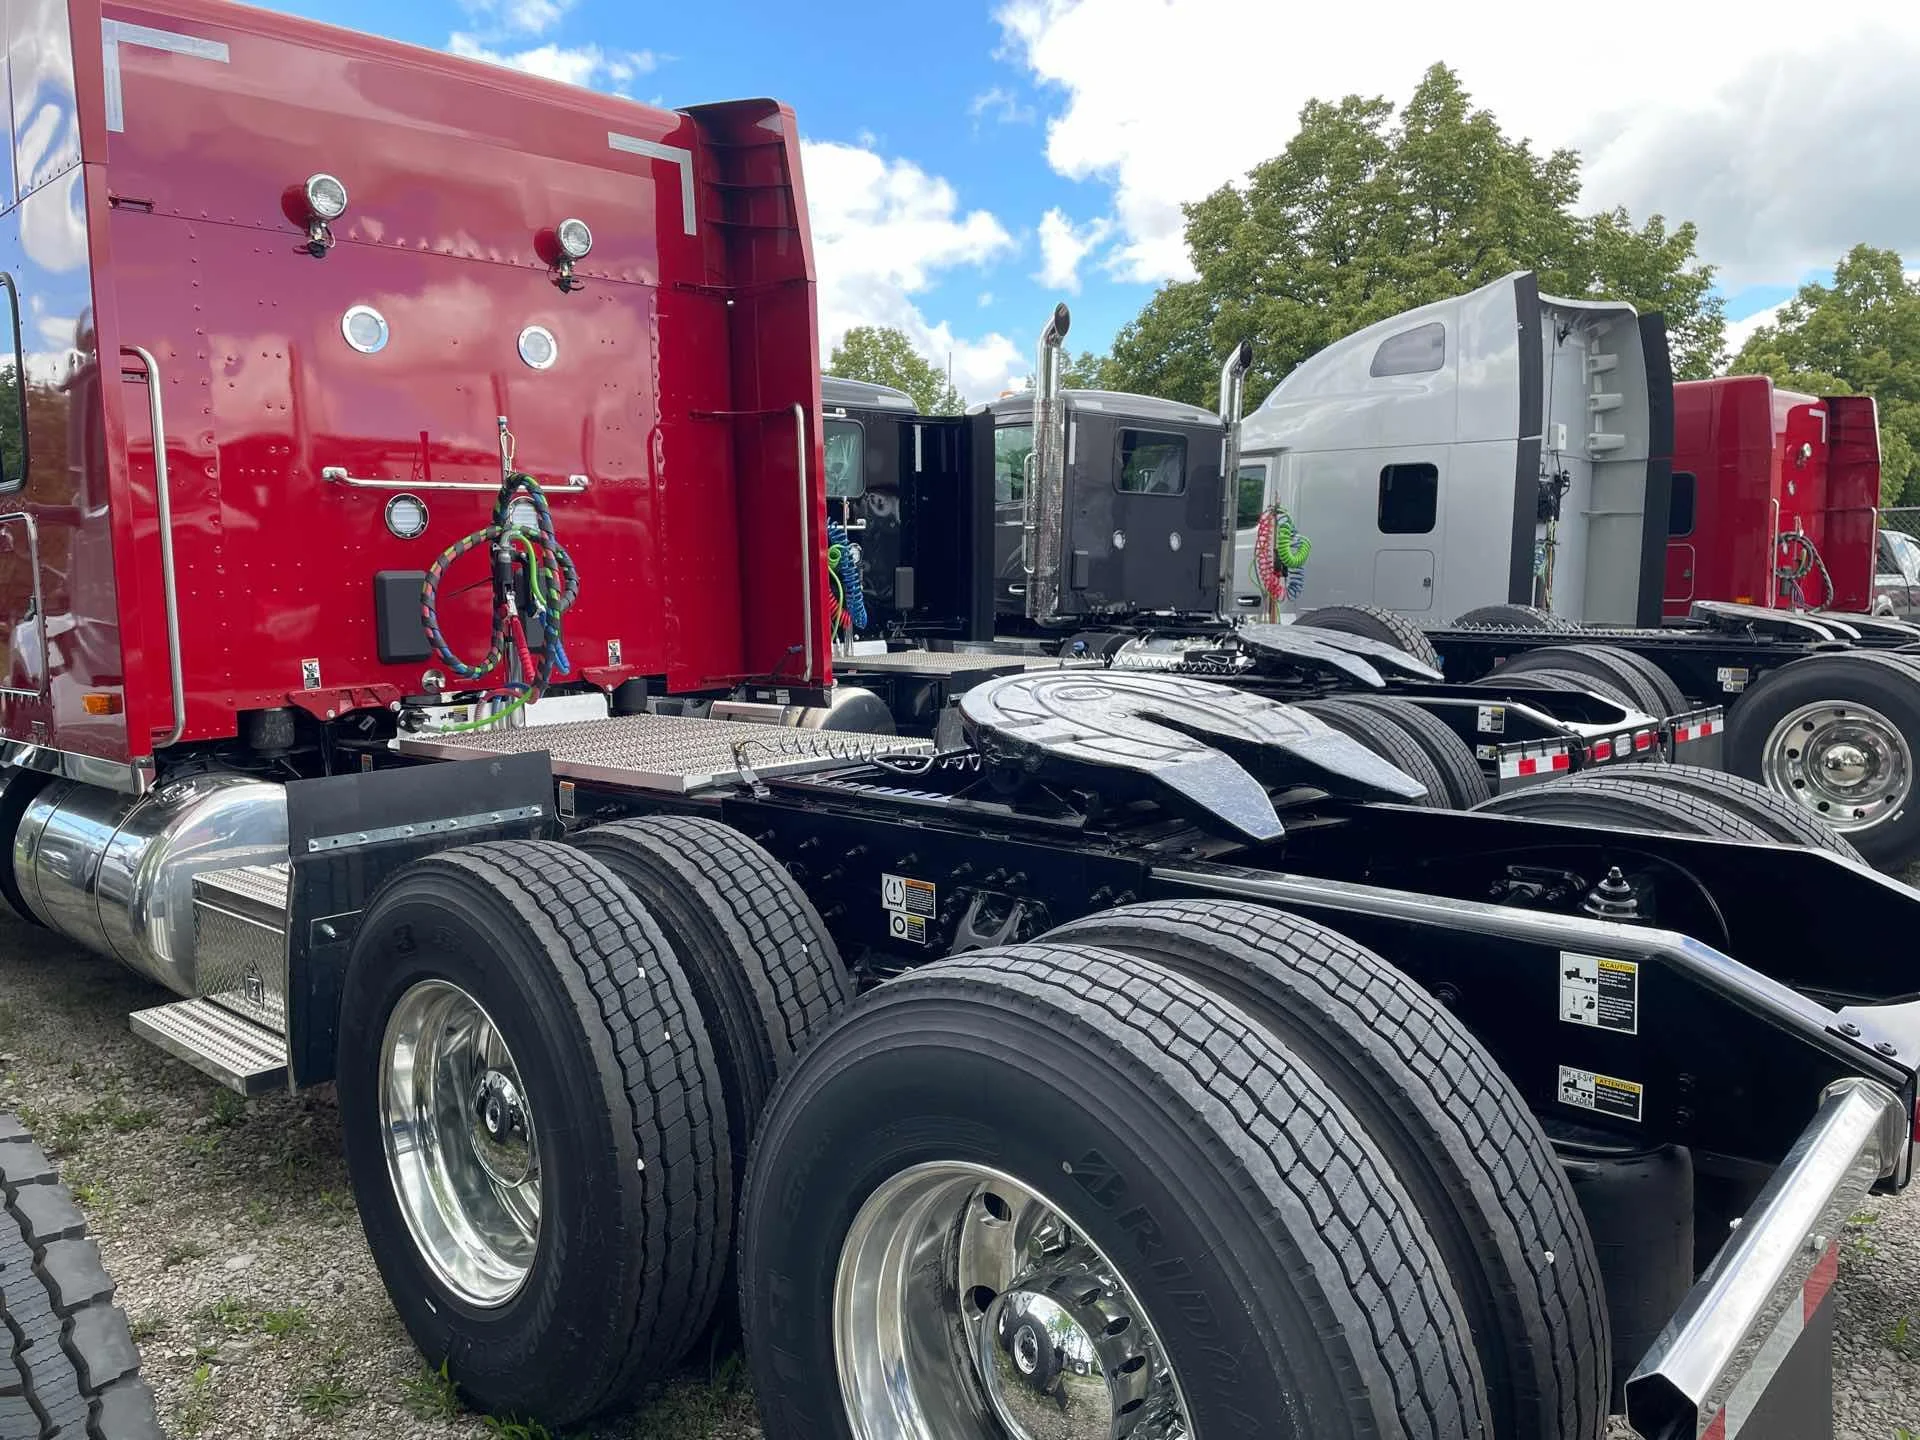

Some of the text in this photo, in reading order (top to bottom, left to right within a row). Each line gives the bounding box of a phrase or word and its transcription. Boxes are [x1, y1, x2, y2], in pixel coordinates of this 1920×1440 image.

[1605, 962, 1635, 972] CAUTION
[1599, 1079, 1636, 1092] ATTENTION
[1562, 1093, 1593, 1107] UNLADEN
